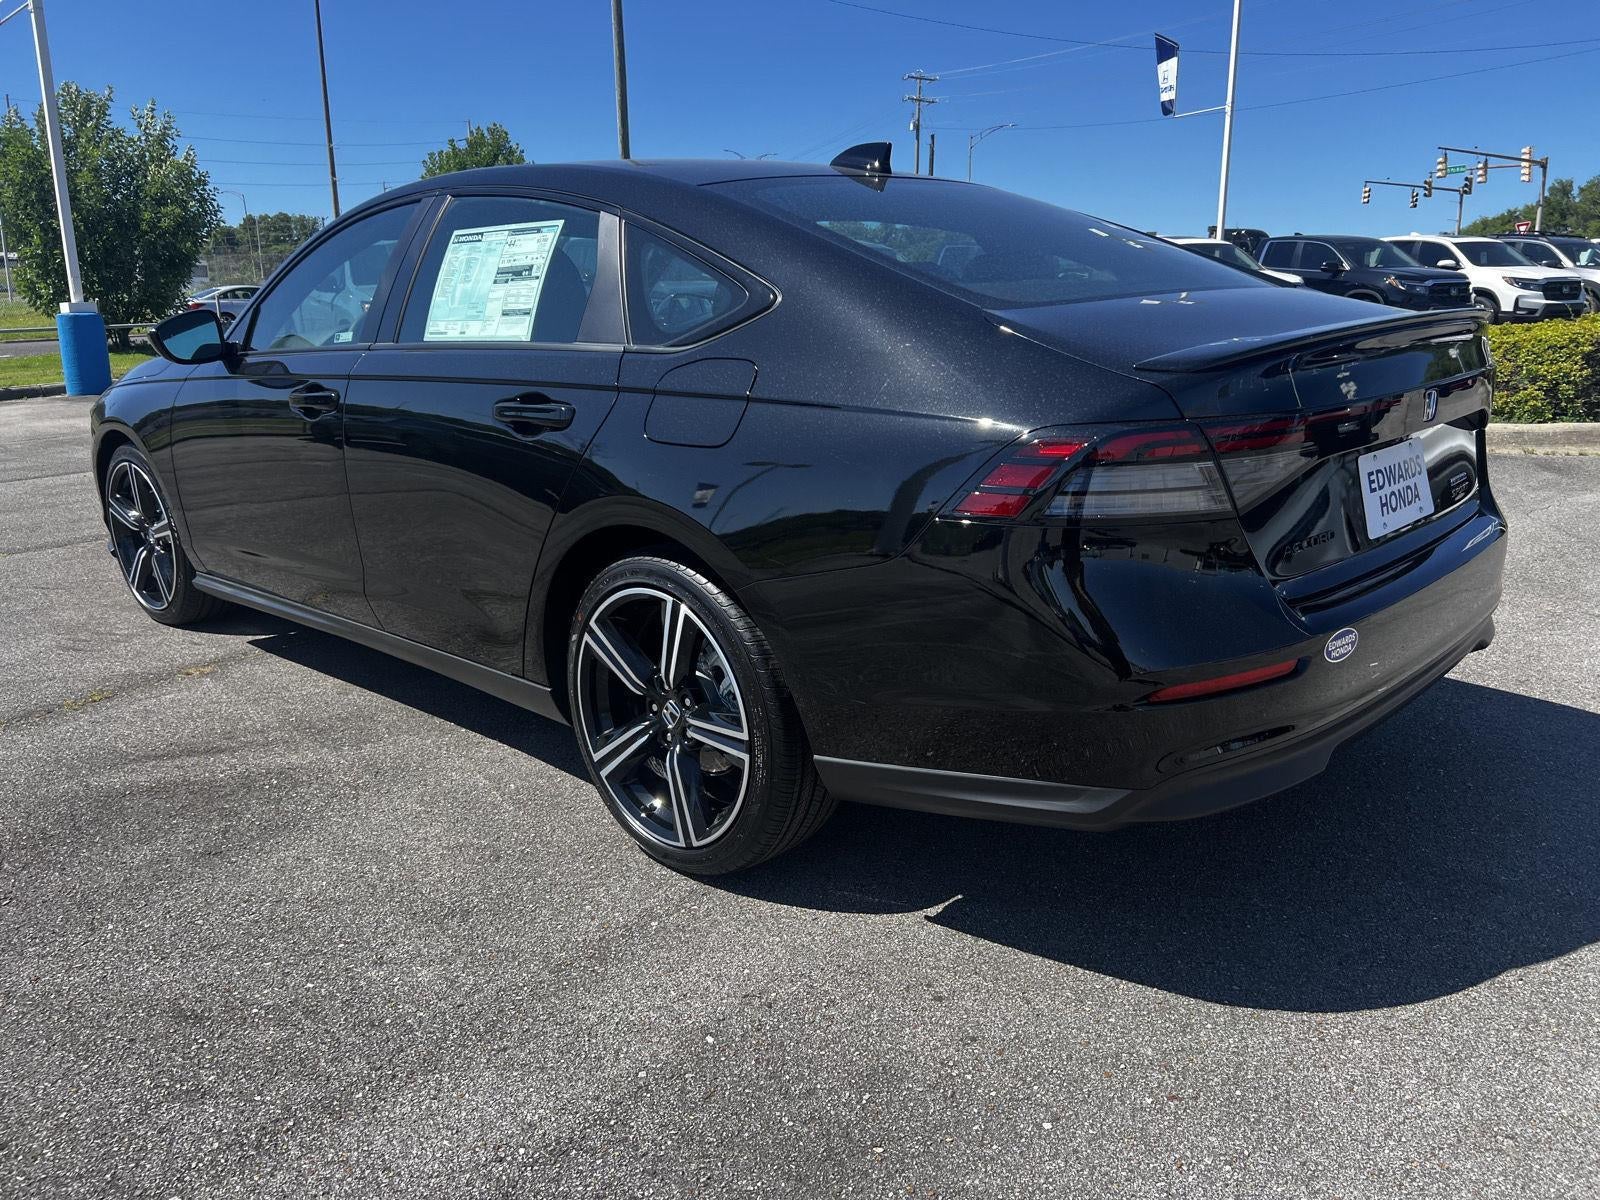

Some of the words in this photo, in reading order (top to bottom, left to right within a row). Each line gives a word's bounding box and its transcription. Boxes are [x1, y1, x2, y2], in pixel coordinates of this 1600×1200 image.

[1367, 454, 1423, 494] EDWARDS
[1379, 482, 1421, 517] HONDA
[1328, 633, 1356, 651] EDWARDS
[1331, 643, 1352, 659] HONDA
